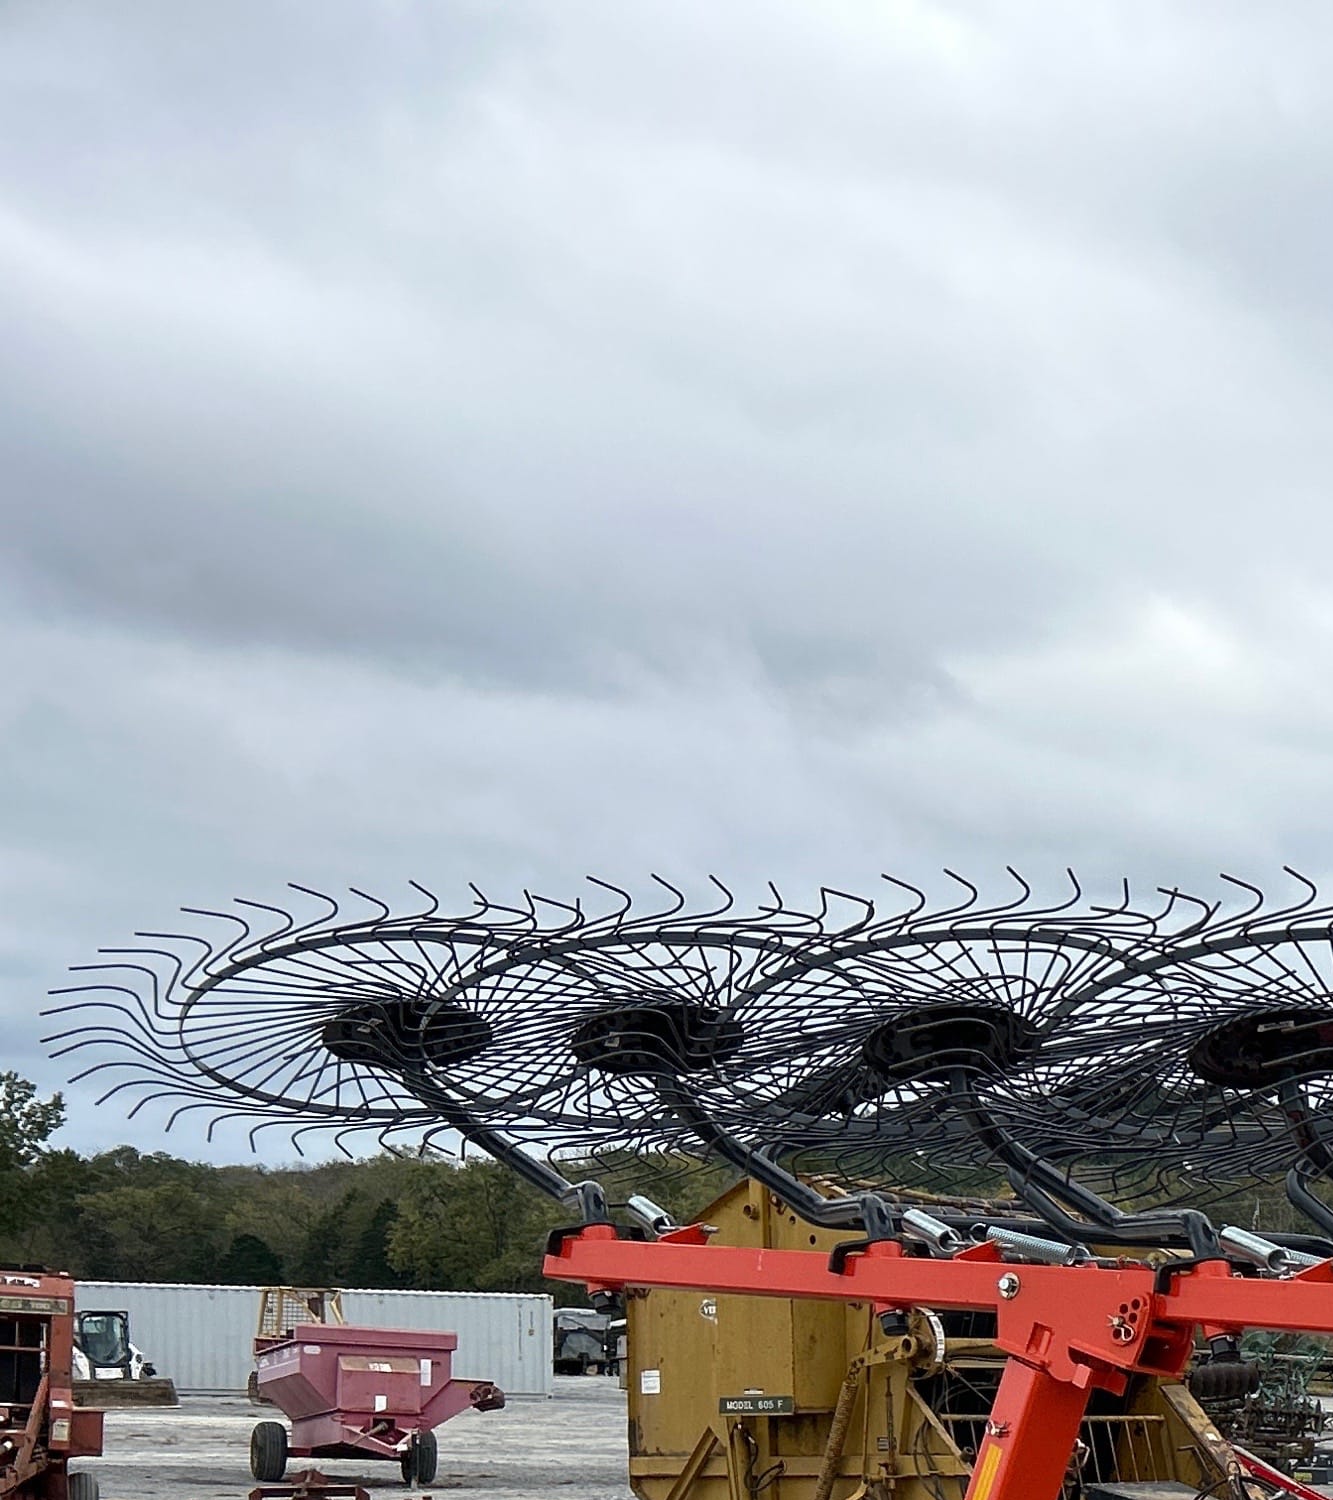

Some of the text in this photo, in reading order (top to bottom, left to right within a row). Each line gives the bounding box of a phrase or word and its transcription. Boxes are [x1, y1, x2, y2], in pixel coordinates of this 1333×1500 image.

[726, 1399, 784, 1410] MODEL 605 F
